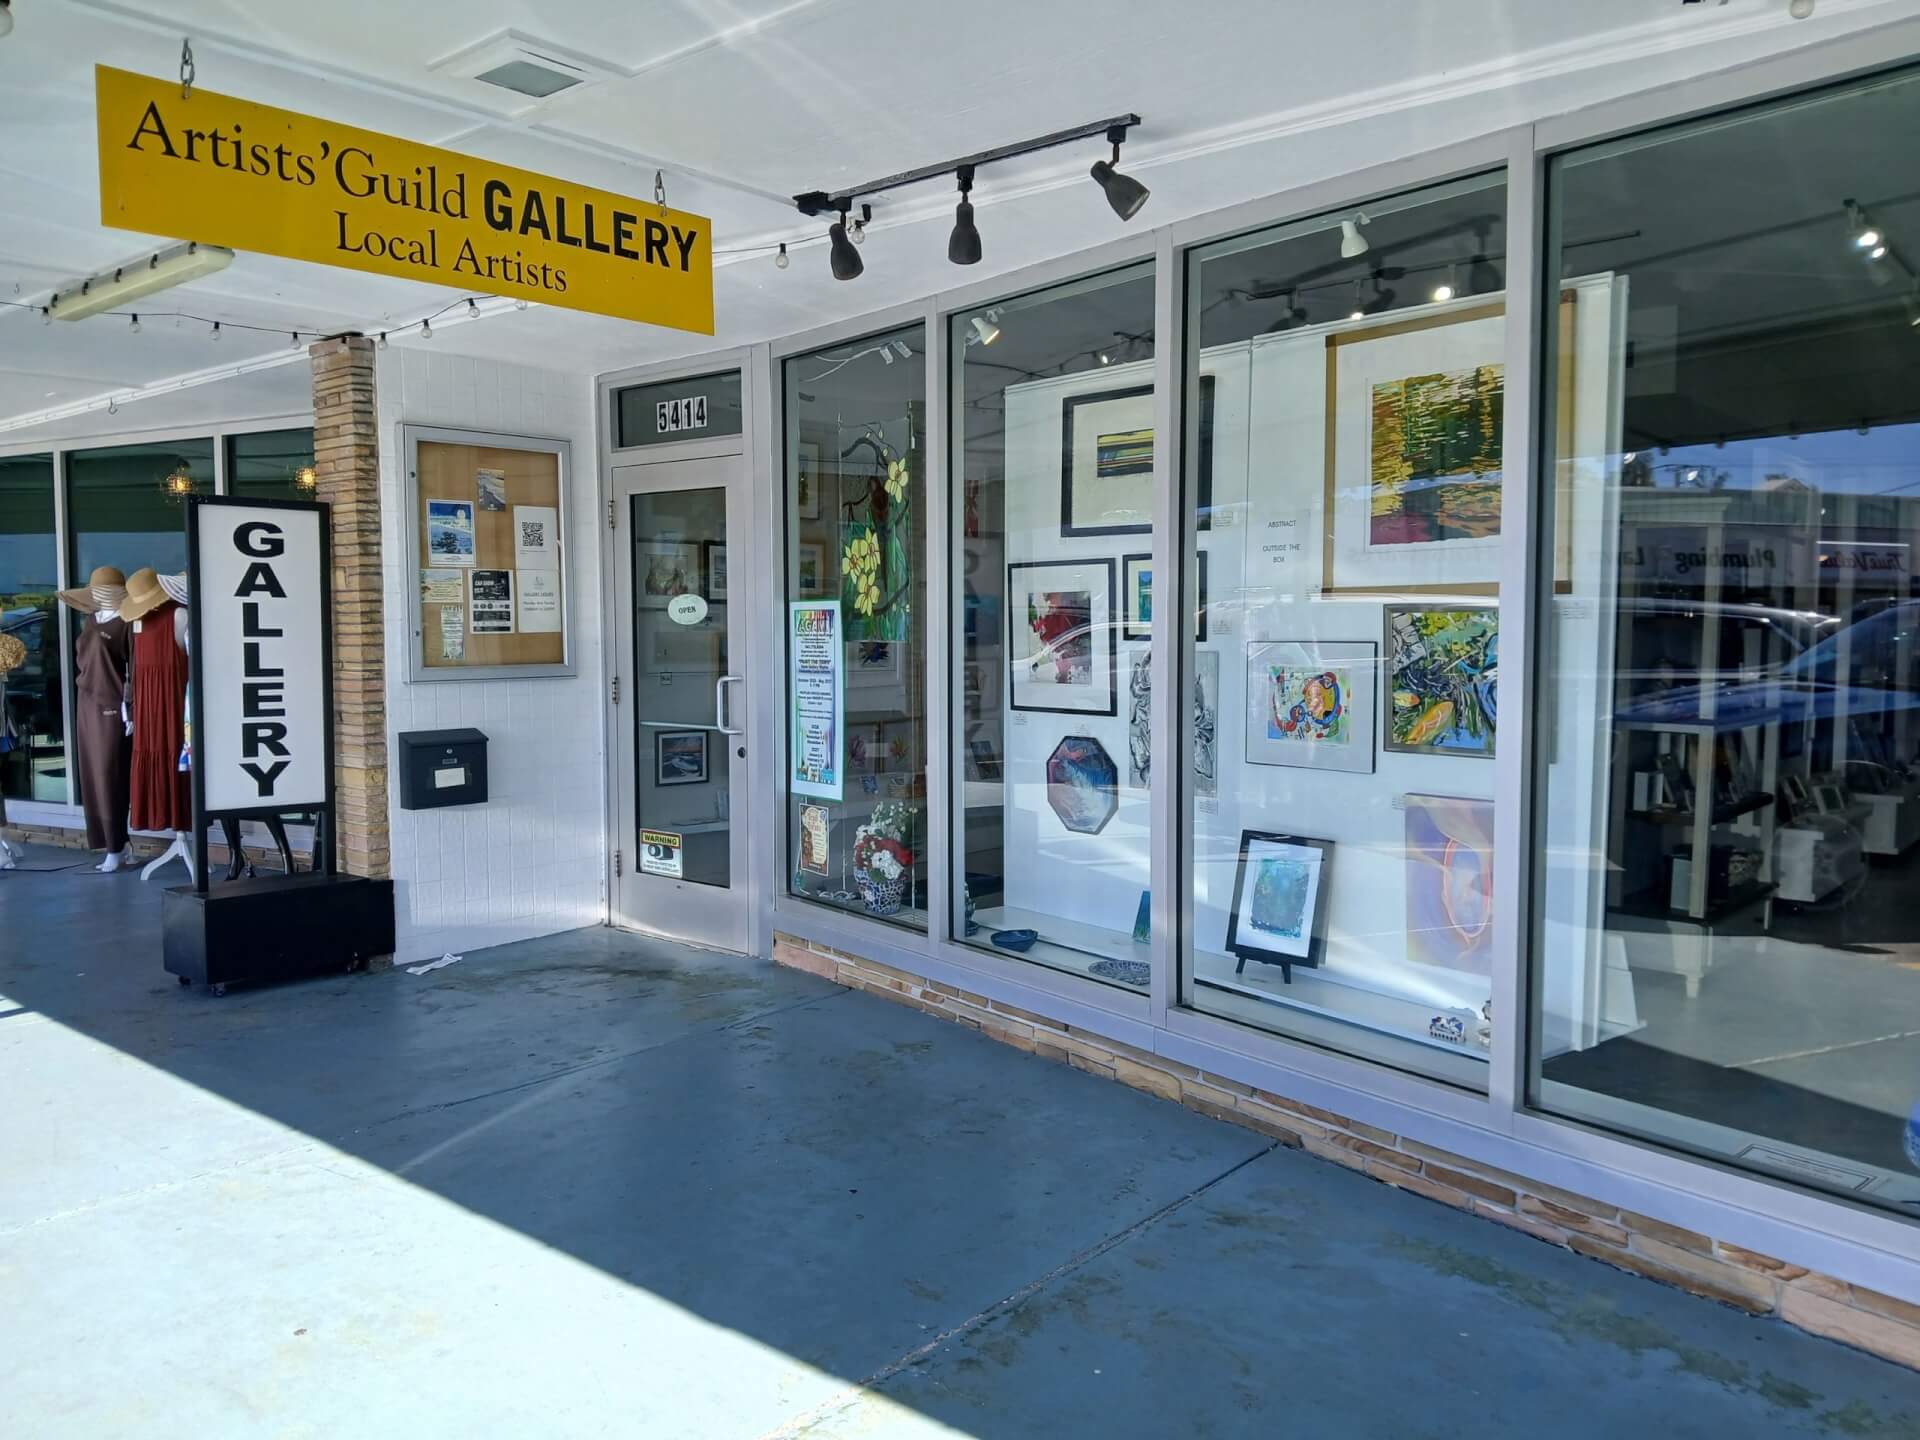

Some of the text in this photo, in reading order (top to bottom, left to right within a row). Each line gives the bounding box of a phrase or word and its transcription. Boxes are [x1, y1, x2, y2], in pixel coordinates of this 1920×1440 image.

[126, 100, 697, 272] Artists' Guild GALLERY
[334, 210, 568, 293] Local Artists
[658, 397, 706, 431] 5414
[1267, 520, 1297, 528] ABSTRACT
[1262, 543, 1301, 552] OUTSIDE THE
[678, 605, 697, 614] OPEN
[233, 521, 292, 798] GALLERY
[644, 834, 678, 845] WARNING
